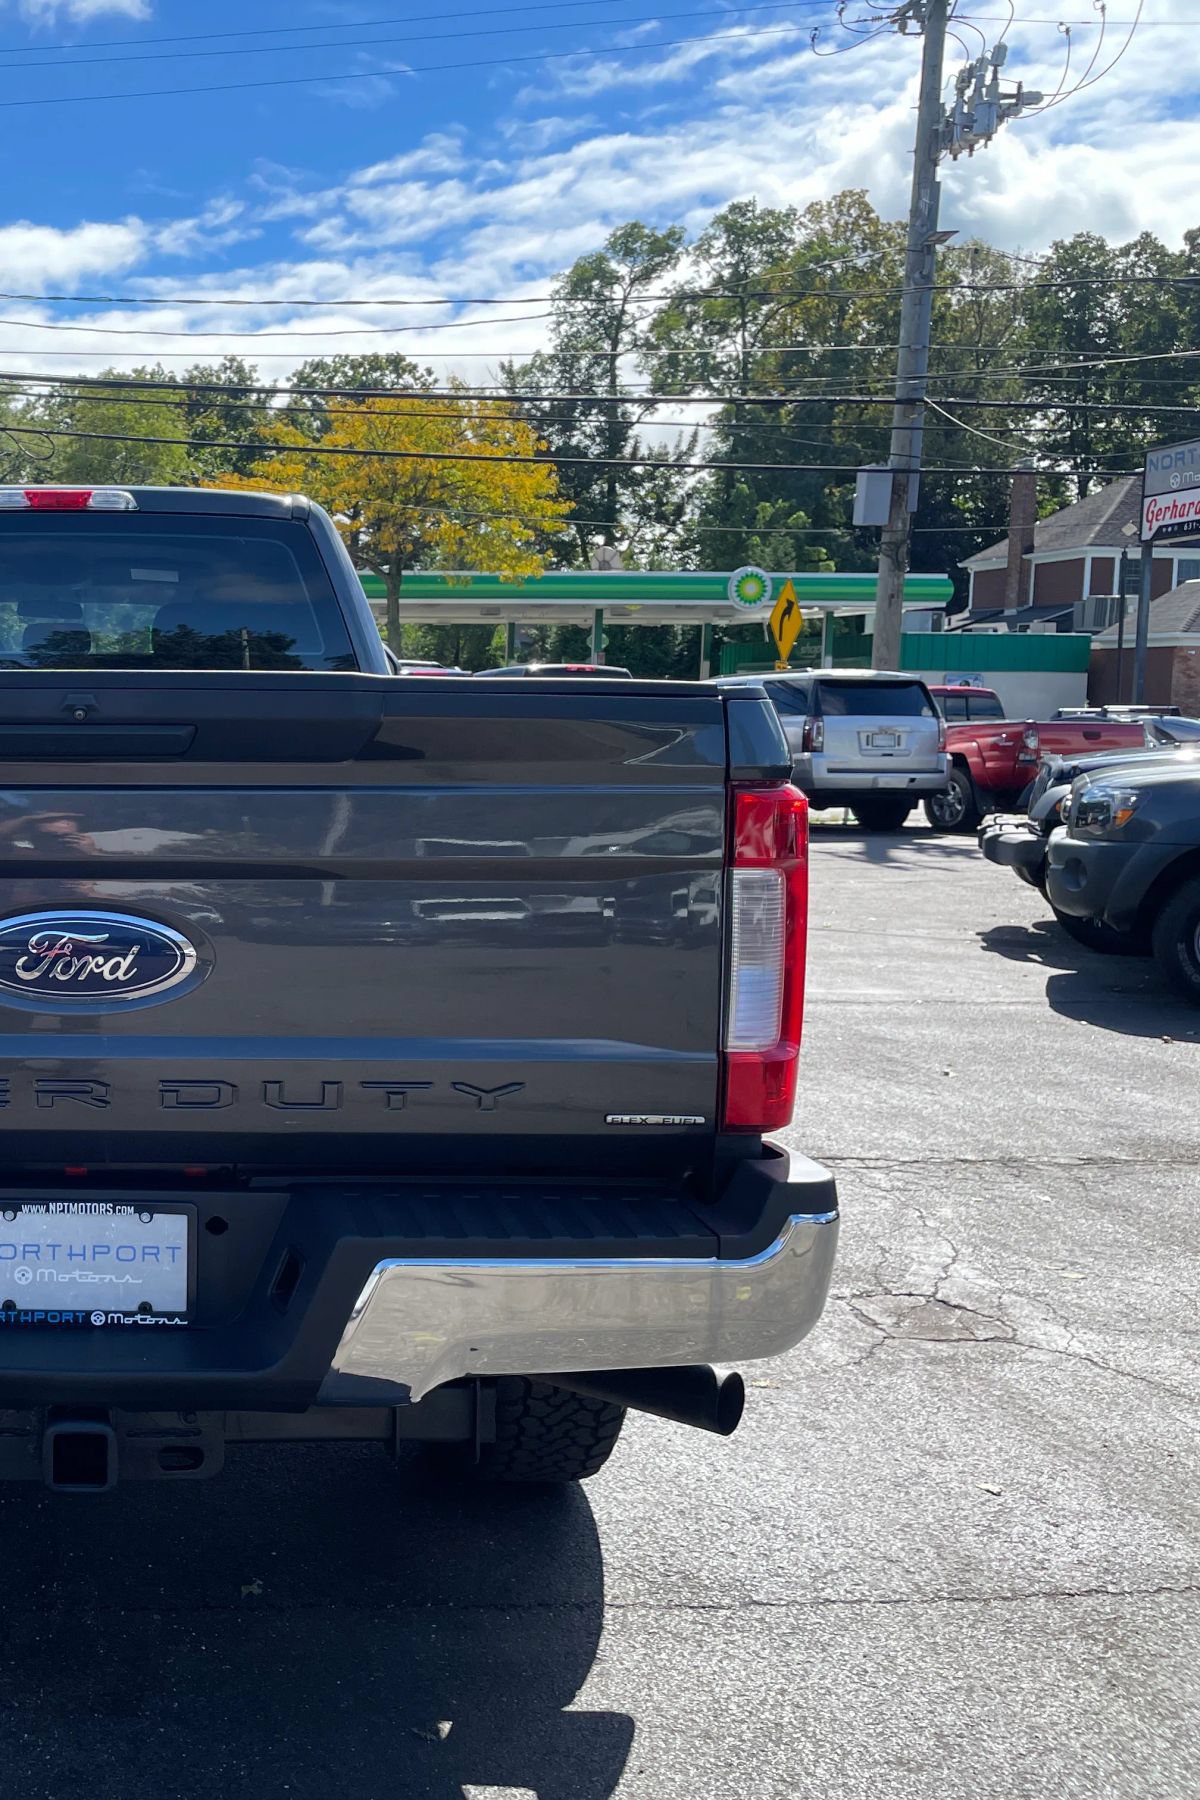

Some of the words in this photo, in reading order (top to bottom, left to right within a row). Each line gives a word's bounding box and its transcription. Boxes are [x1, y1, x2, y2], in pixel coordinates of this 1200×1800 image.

[1149, 448, 1200, 471] NORT
[15, 930, 141, 981] Ford
[158, 1078, 527, 1112] DUTY
[611, 1117, 649, 1125] FLEX
[662, 1117, 701, 1125] FUEL
[21, 1202, 135, 1216] WWW.NPTMOTORS.COM
[36, 1268, 143, 1284] Motors
[107, 1312, 188, 1325] Motors
